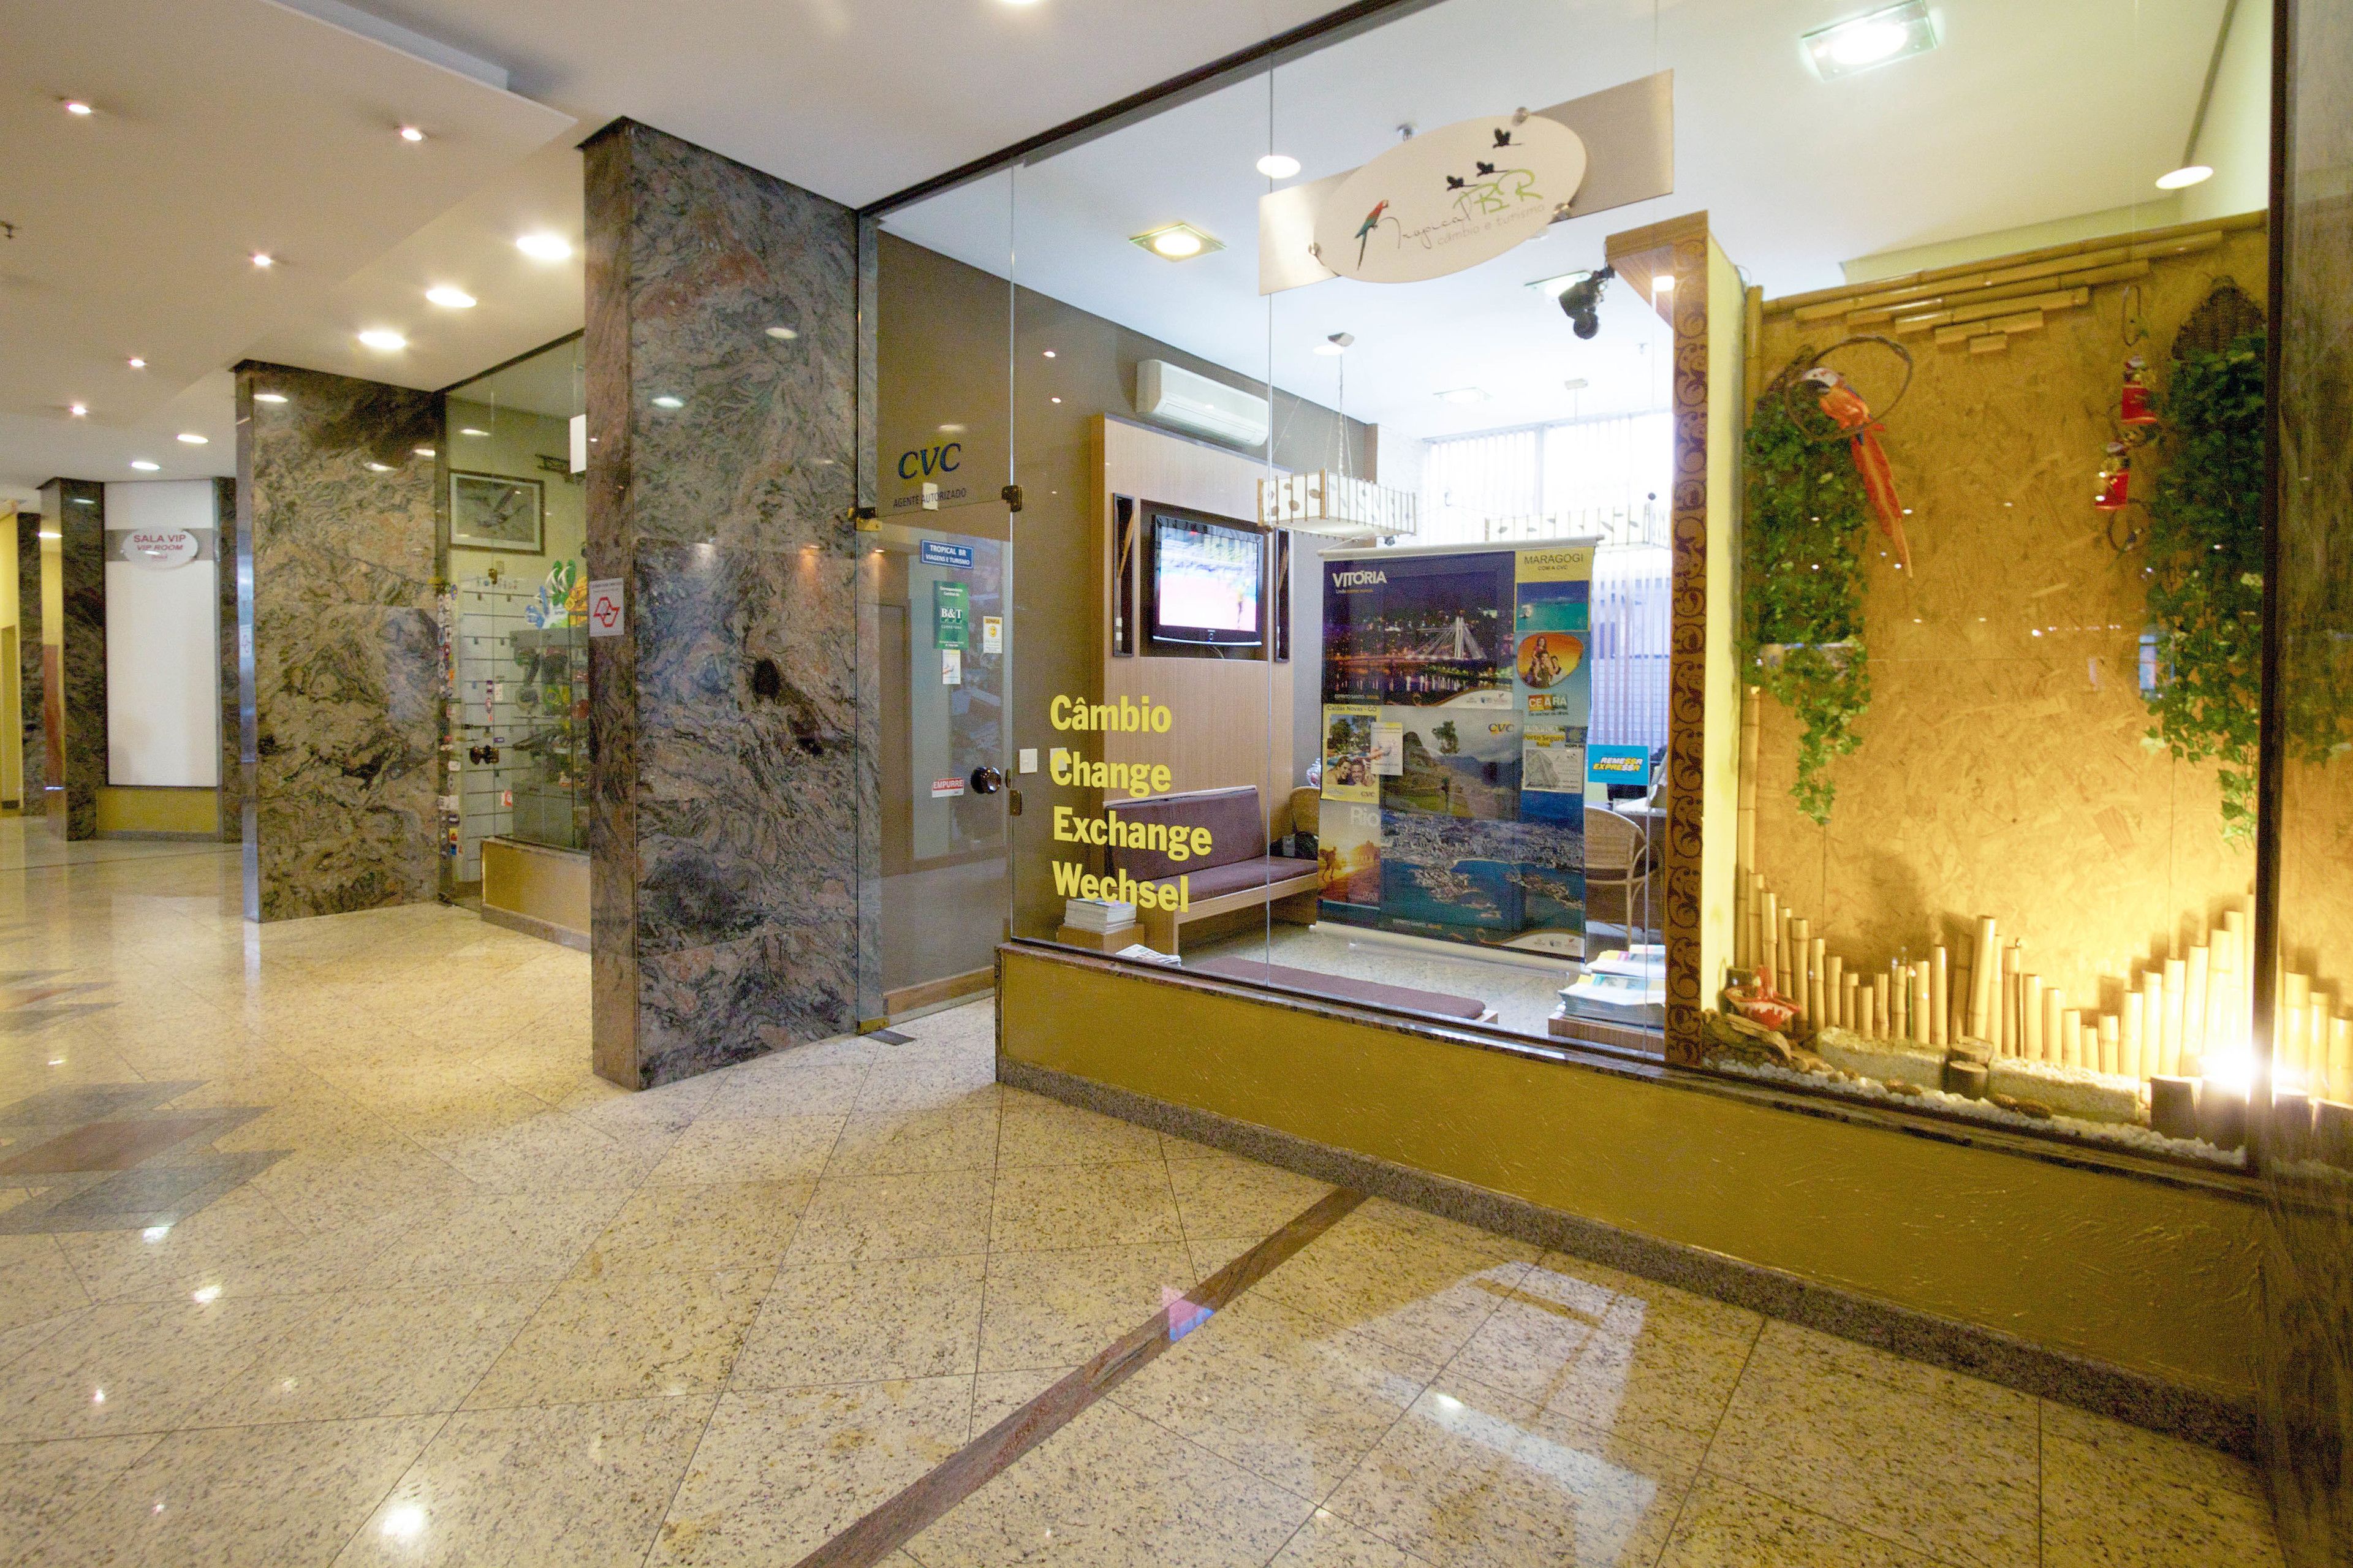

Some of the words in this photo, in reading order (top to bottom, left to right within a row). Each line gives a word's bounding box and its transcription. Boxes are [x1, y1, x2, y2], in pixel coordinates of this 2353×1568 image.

[898, 442, 961, 480] CVC
[893, 495, 919, 508] AGENTE
[921, 488, 967, 503] AUTORIZADO
[134, 534, 164, 543] SALA
[167, 534, 186, 543] VIP
[930, 544, 957, 555] TROPICAL
[925, 553, 945, 562] VIAGENS
[950, 557, 971, 566] TURISMO
[1524, 553, 1584, 564] MARAGOGI
[941, 607, 963, 619] B&T
[1050, 694, 1172, 733] Câmbio
[1488, 722, 1515, 733] CVC
[1543, 735, 1566, 743] Seguro
[1593, 763, 1640, 771] EXPRESSA
[1600, 757, 1643, 765] REMESSA
[1050, 749, 1172, 798] Change
[933, 779, 963, 789] EMPURRE
[1350, 806, 1379, 827] Rio
[1053, 805, 1213, 862] Exchange
[1051, 860, 1189, 913] Wechsel
